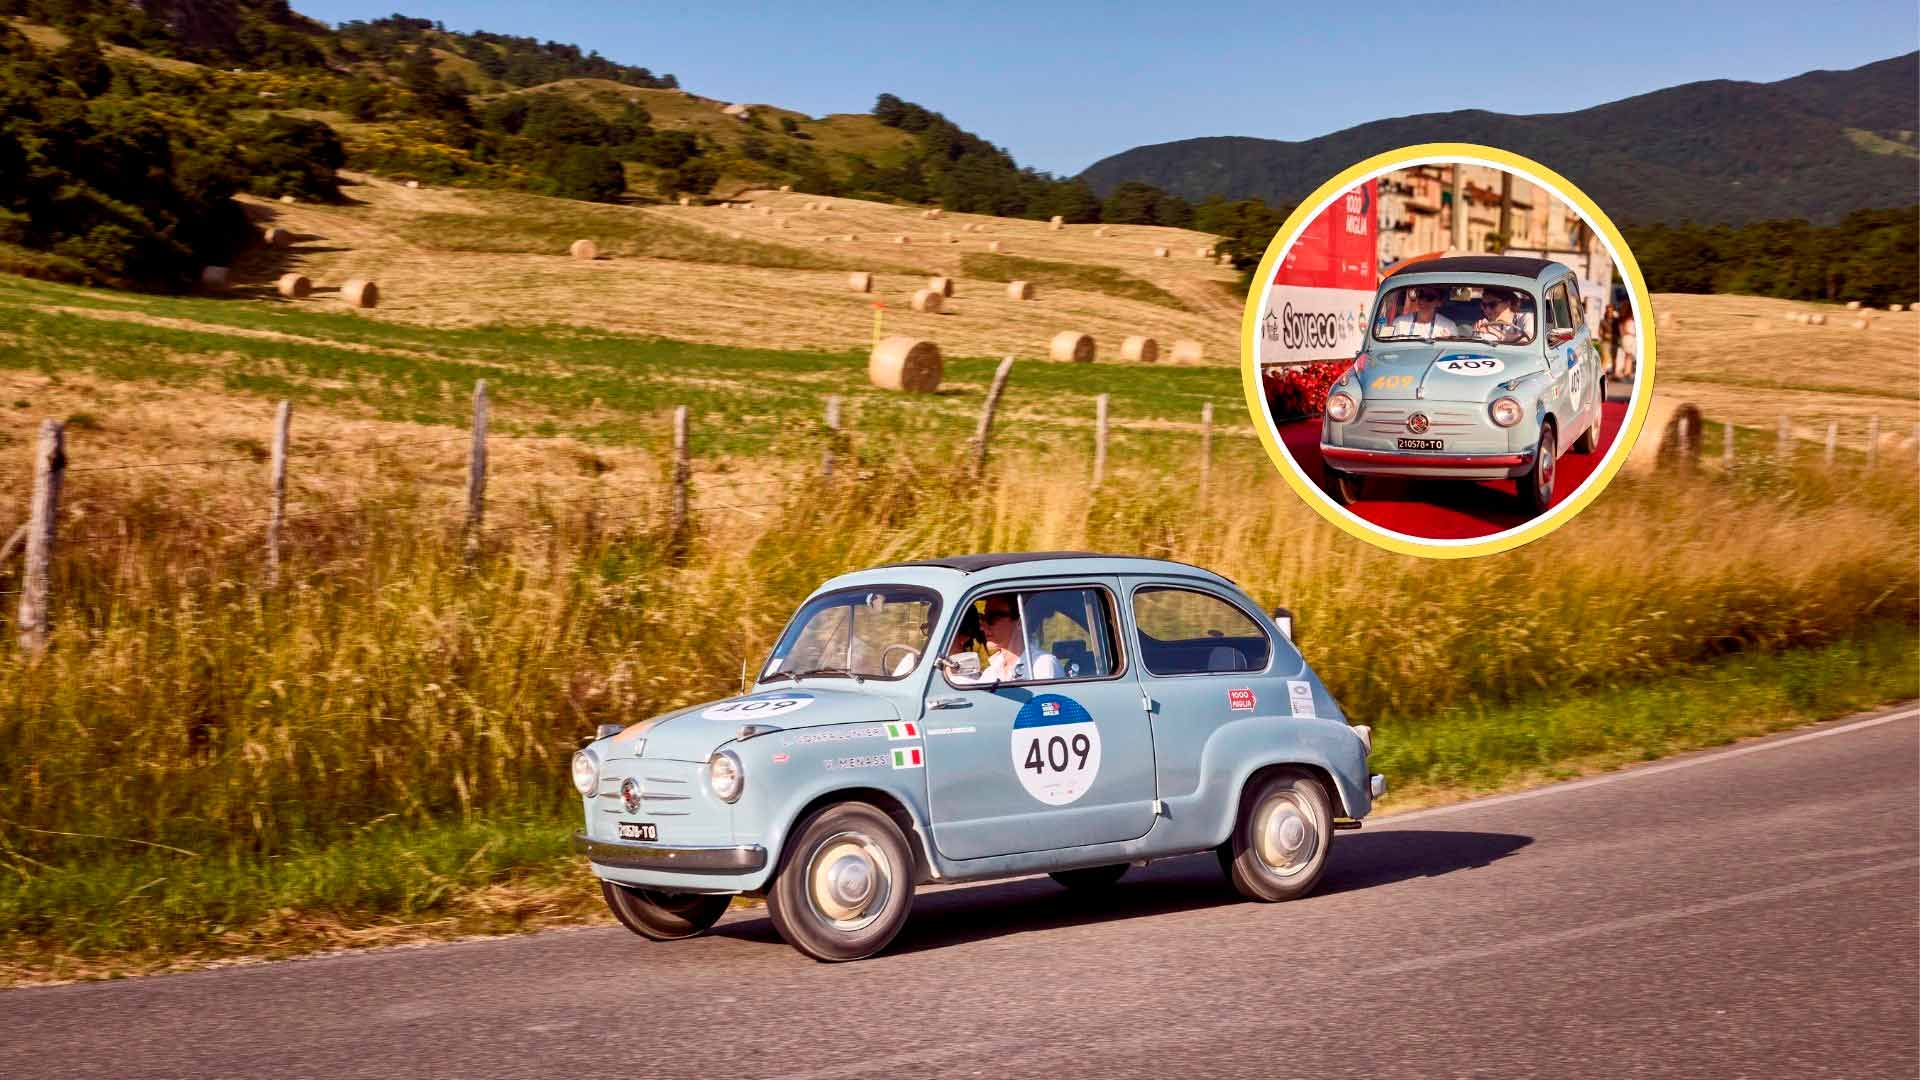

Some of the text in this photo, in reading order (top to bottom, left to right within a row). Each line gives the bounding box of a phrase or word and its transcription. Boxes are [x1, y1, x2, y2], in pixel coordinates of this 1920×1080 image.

[1283, 301, 1337, 349] Soveco
[1447, 360, 1496, 370] 409
[1371, 375, 1414, 389] 409
[714, 700, 798, 712] 409
[1024, 733, 1090, 774] 409
